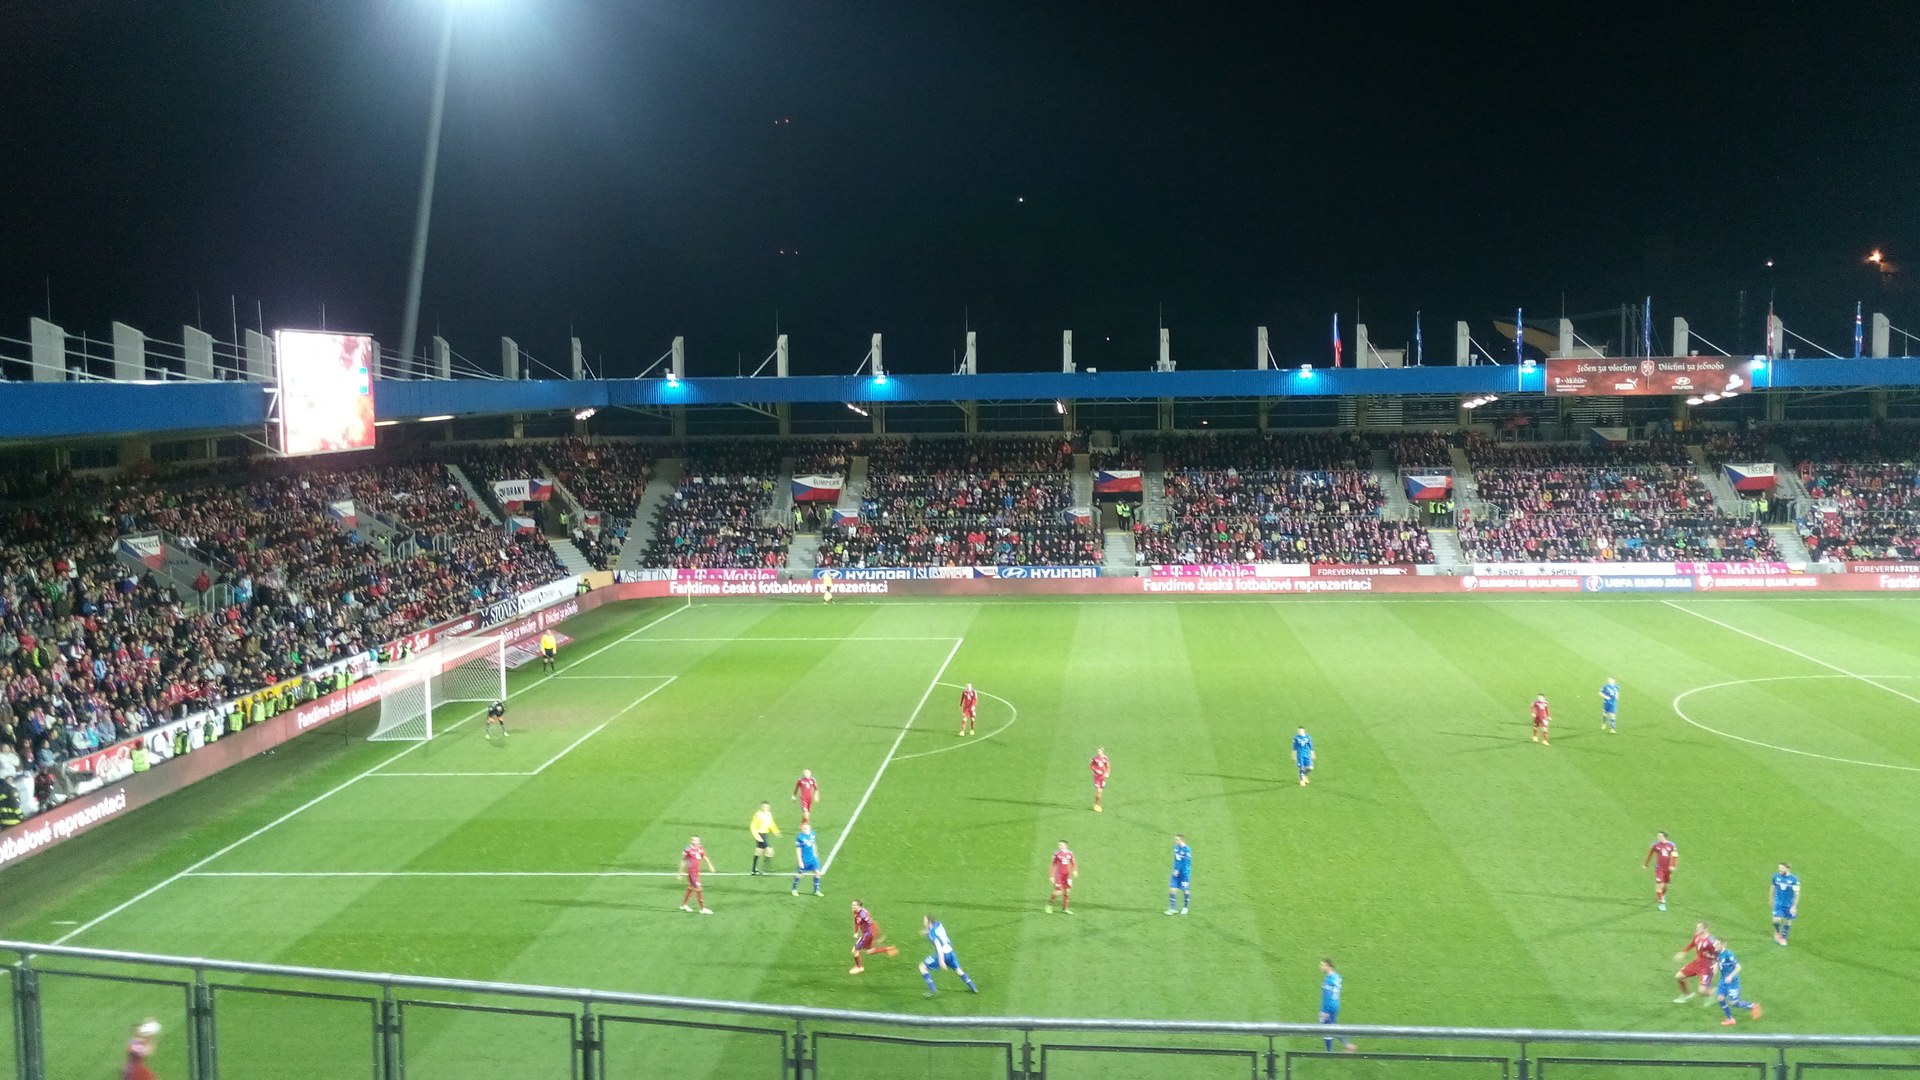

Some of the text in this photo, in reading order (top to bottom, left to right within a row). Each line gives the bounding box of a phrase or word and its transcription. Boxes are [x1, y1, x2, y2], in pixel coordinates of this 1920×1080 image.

[1598, 365, 1607, 373] za
[1686, 364, 1695, 372] za
[846, 567, 911, 580] HYUNDAI
[1031, 567, 1097, 579] HYUNDAI
[669, 580, 721, 594] Fandíme
[721, 580, 756, 593] české
[758, 580, 813, 593] fotbalové
[1143, 576, 1372, 592] Fandíme české fotbalové reprezentaci
[52, 787, 127, 838] reprezentaci
